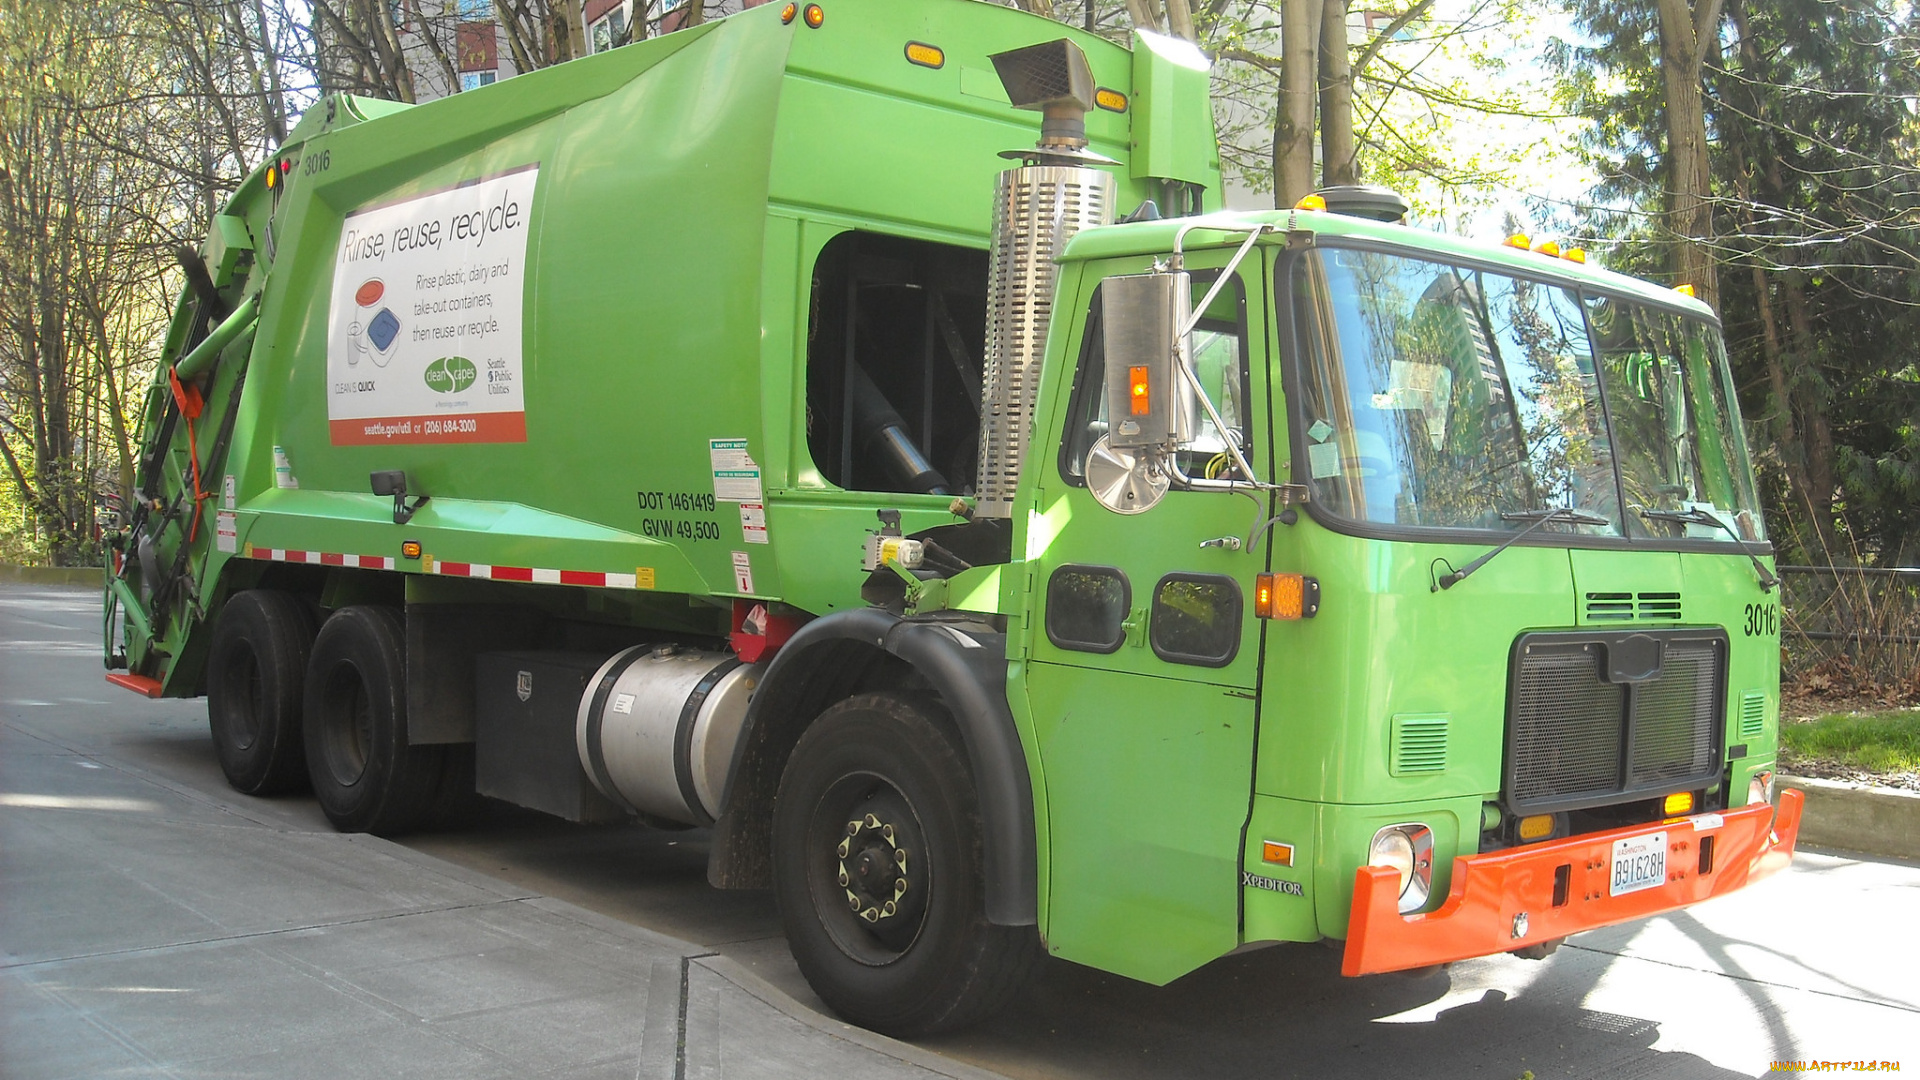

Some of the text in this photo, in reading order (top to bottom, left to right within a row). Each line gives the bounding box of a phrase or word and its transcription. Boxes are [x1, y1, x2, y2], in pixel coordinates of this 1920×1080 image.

[305, 149, 330, 176] 3016
[343, 189, 521, 263] Rinse, reuse, recycle.
[415, 256, 509, 291] Rinse plastic, dairy and
[414, 291, 493, 316] take-out containers,
[412, 314, 500, 342] then reuse or recycle.
[487, 357, 506, 370] Seattle
[494, 370, 512, 382] Public
[335, 383, 351, 394] CLEAN
[358, 381, 376, 392] QUICK
[487, 383, 510, 395] Utilities
[364, 419, 476, 438] seattle.gov/util or (206) 684-3000
[637, 491, 715, 512] DOT 1461419
[642, 518, 673, 538] GVW
[677, 520, 720, 543] 49,500
[1744, 603, 1777, 637] 3016
[1617, 844, 1647, 856] WASHINGTON
[1614, 851, 1664, 887] B91628H
